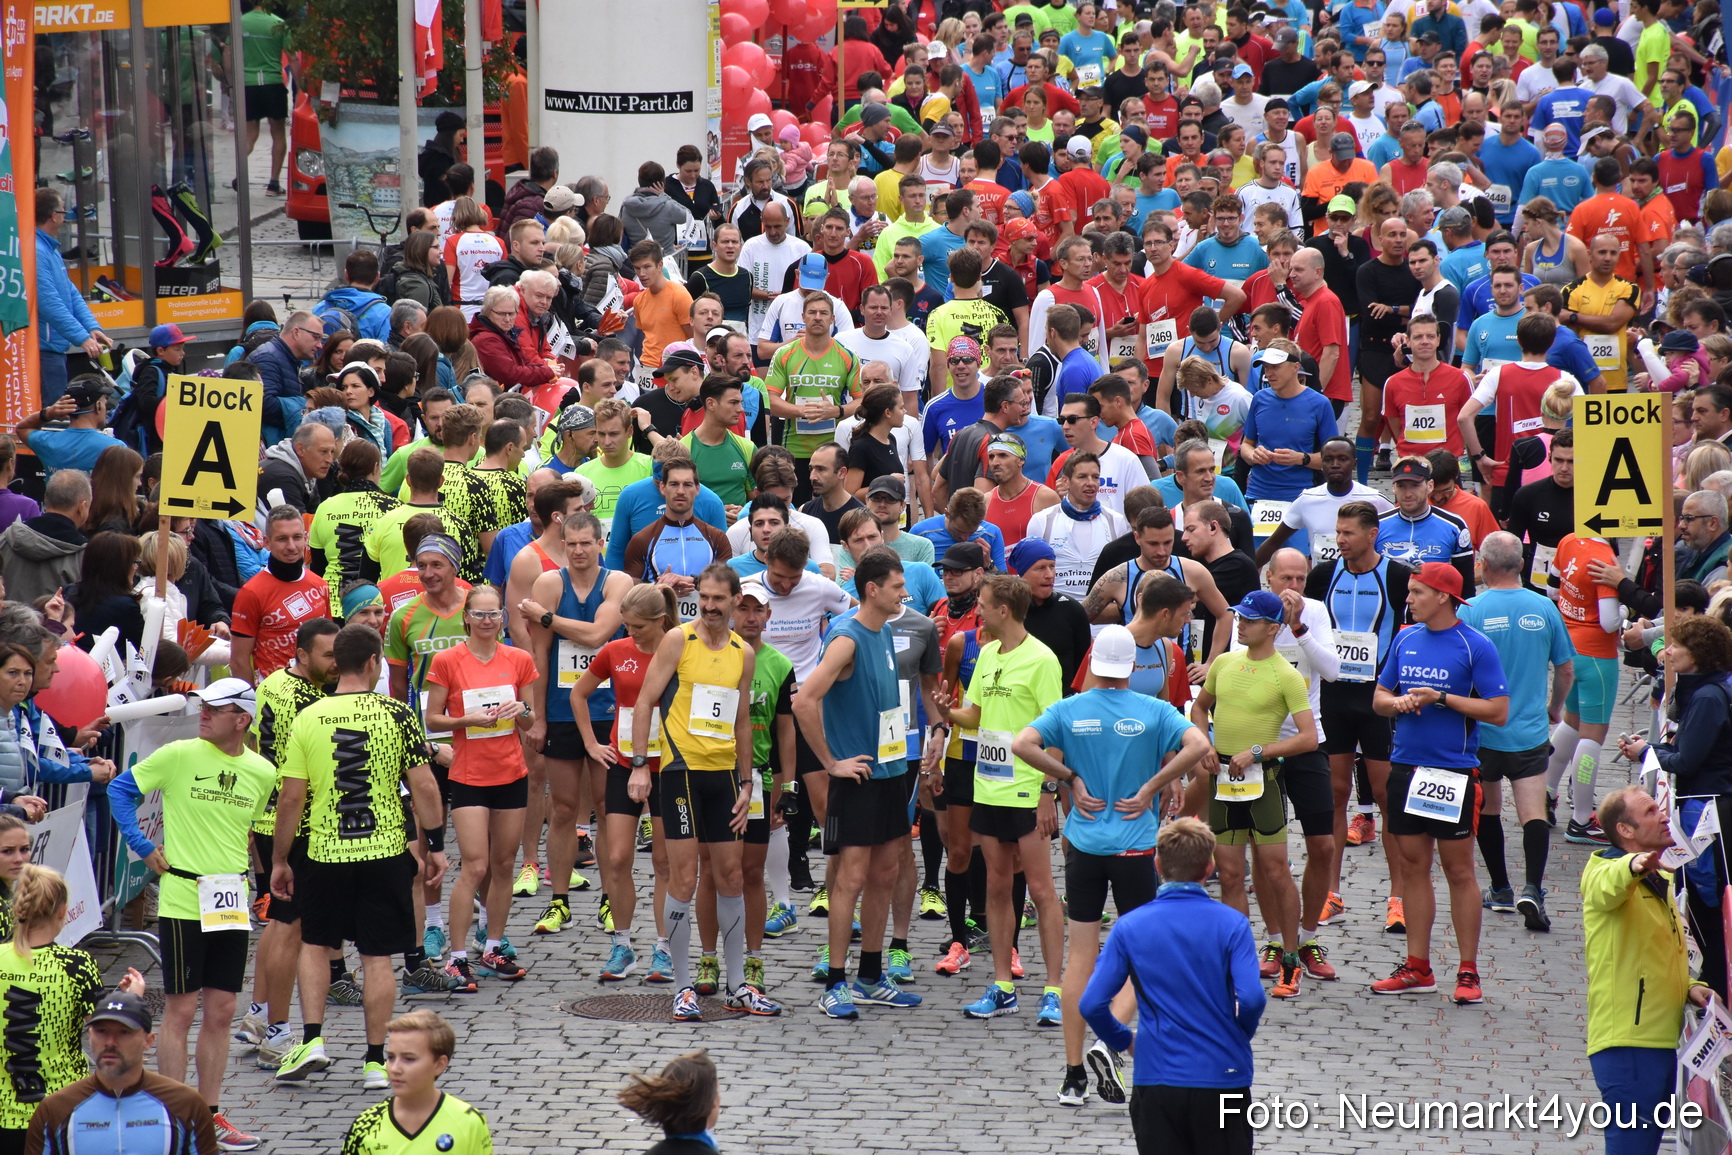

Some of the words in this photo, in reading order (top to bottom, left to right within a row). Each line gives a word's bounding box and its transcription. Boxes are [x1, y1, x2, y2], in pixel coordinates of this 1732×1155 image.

[1084, 72, 1094, 80] 52
[546, 94, 688, 112] www.MINI-Partl.de
[171, 285, 198, 296] cep
[172, 306, 227, 317] Bewegungsanalyse
[1150, 331, 1173, 344] 2469
[1592, 345, 1612, 357] 282
[788, 374, 841, 388] BOCK
[179, 381, 253, 411] Block
[1585, 399, 1661, 426] Block
[1412, 417, 1436, 429] 402
[181, 420, 237, 490] A
[1594, 437, 1653, 506] A
[326, 513, 350, 521] Team
[352, 511, 374, 519] Partl
[1260, 510, 1282, 522] 299
[770, 617, 812, 627] Raiffeisenbank
[1336, 644, 1369, 662] 2706
[1401, 665, 1449, 681] SYSCAD
[712, 702, 722, 718] 5
[318, 715, 350, 726] Team
[353, 711, 381, 723] Partl
[888, 724, 894, 740] 1
[1117, 722, 1142, 733] Hervis
[980, 743, 1007, 763] 2000
[1417, 781, 1456, 802] 2295
[1422, 801, 1445, 812] Andreas
[213, 891, 239, 909] 201
[28, 972, 57, 984] Partl
